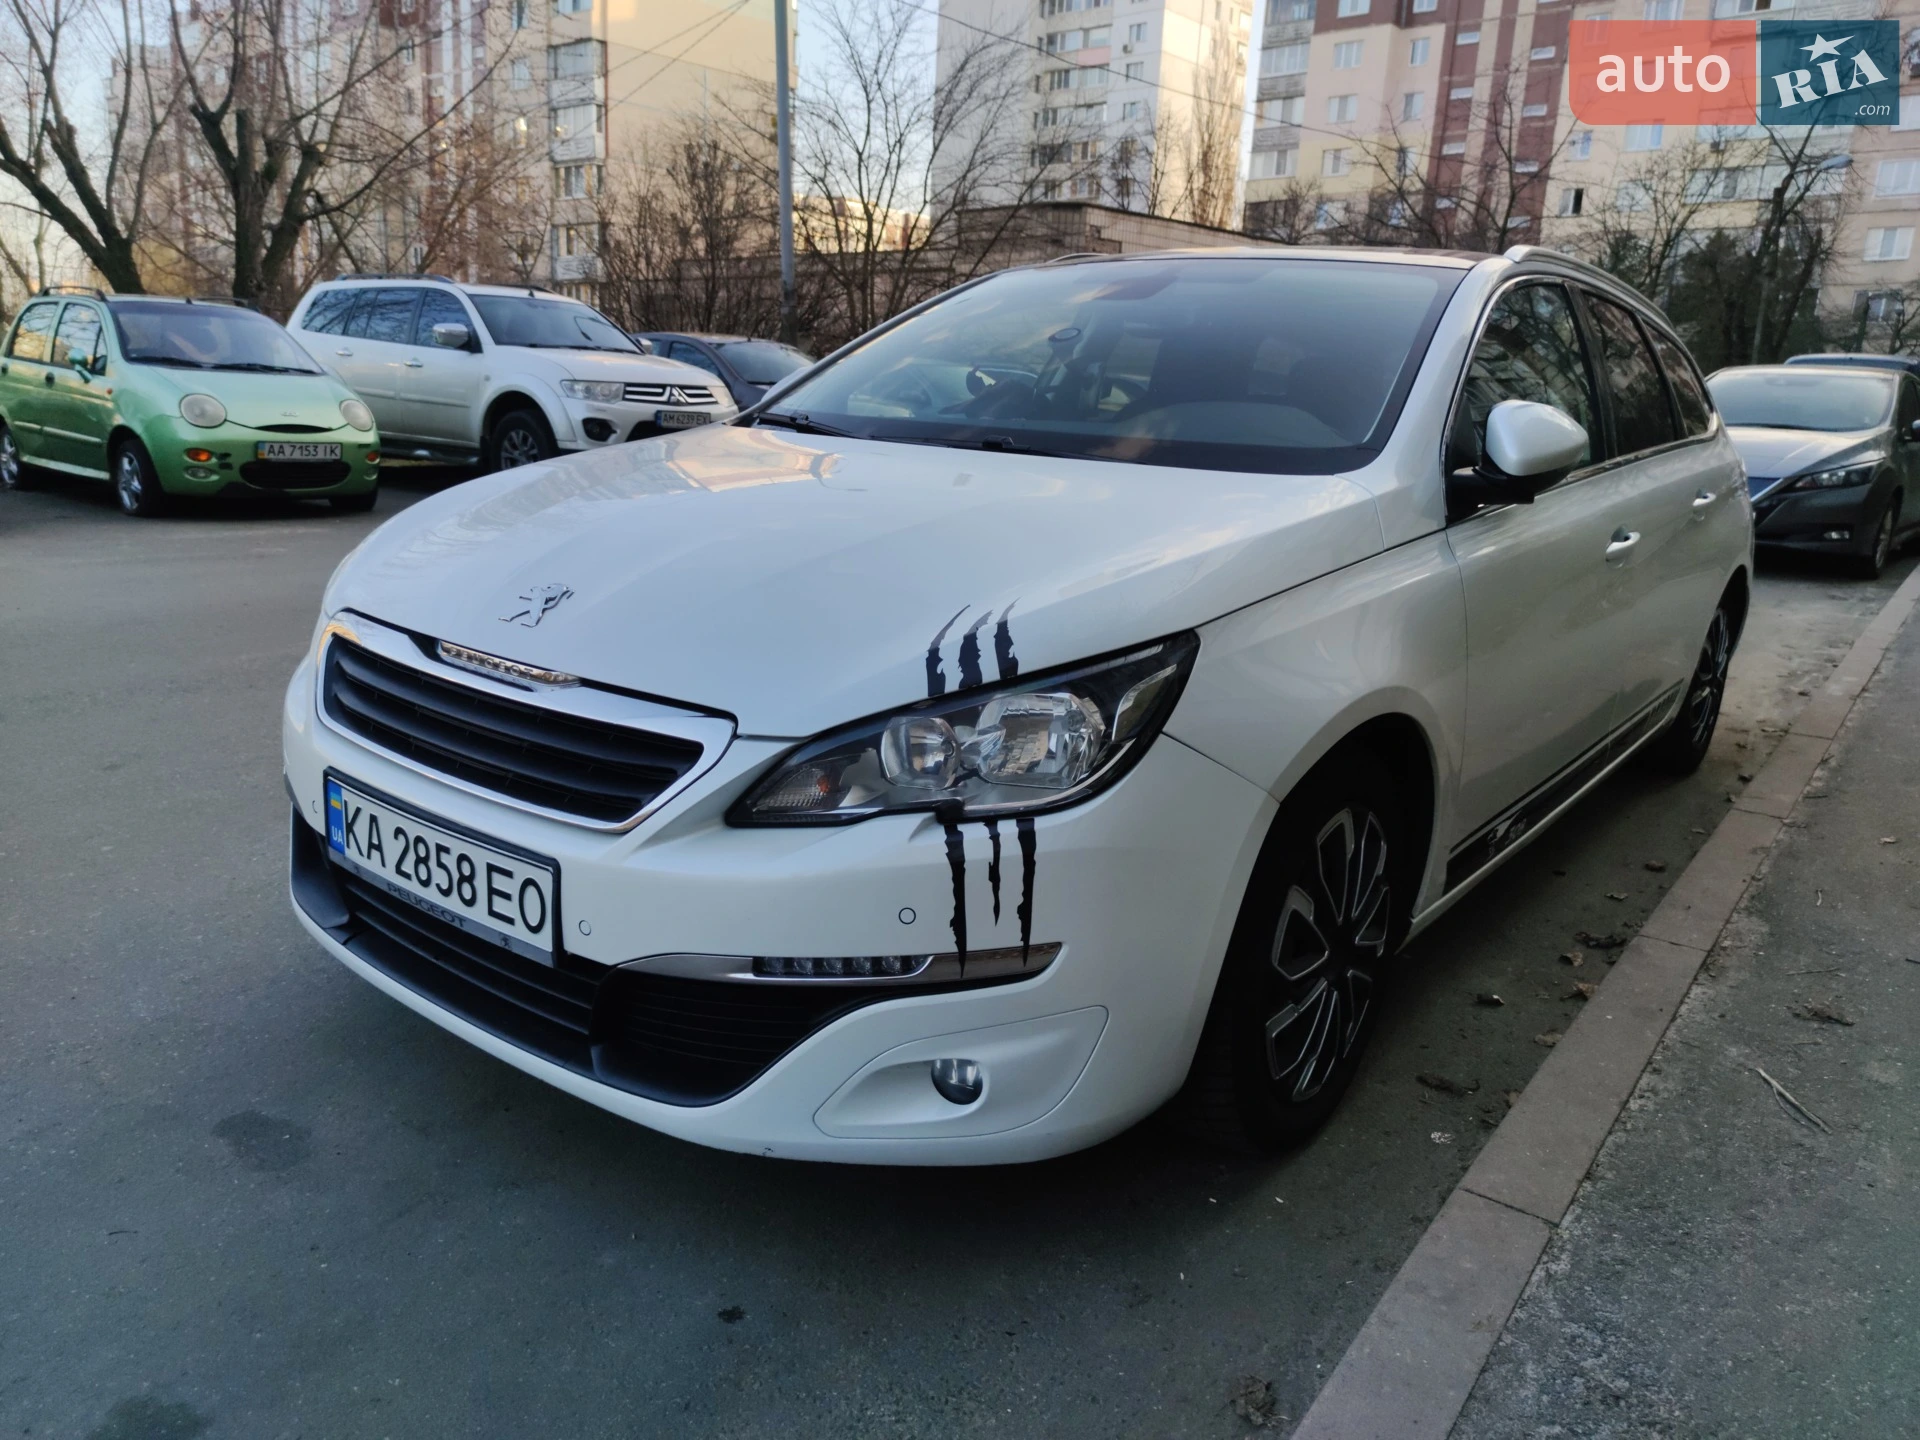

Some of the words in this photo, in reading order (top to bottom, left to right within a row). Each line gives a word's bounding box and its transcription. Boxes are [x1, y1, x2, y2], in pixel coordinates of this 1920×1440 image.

[267, 444, 286, 457] AA
[289, 444, 319, 457] 7153
[324, 445, 339, 457] IK
[449, 646, 534, 680] PEUGEOT
[331, 825, 344, 845] UA
[344, 799, 386, 868] KA
[393, 825, 477, 908] 2858
[486, 861, 546, 934] EO
[386, 882, 467, 928] PEUGEOT
